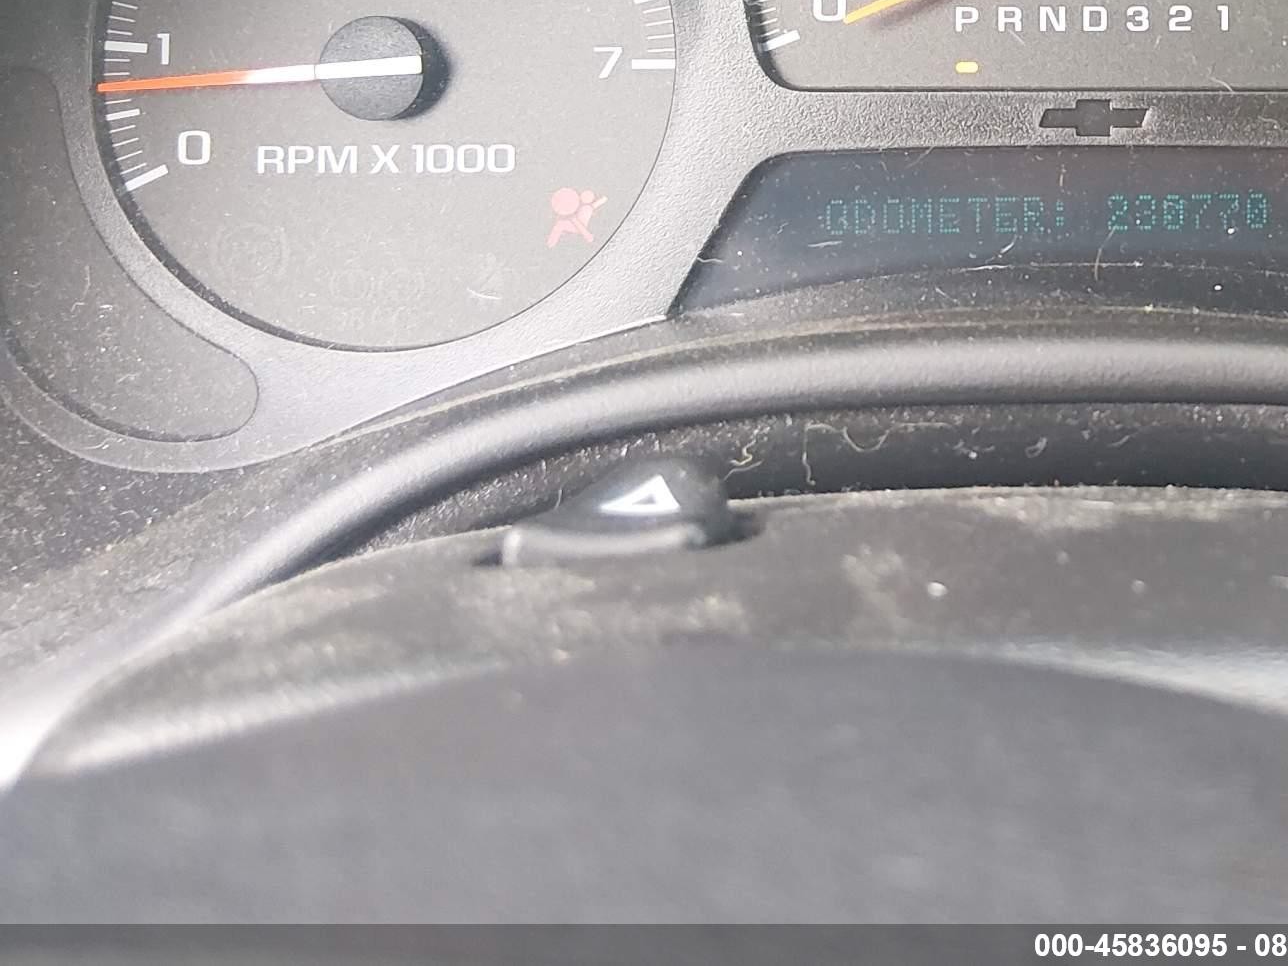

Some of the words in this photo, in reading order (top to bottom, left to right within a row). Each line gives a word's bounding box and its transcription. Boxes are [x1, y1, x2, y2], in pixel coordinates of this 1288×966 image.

[955, 6, 979, 32] P
[997, 6, 1022, 32] R
[1039, 6, 1066, 32] N
[1082, 5, 1108, 32] D
[1126, 5, 1150, 32] 3
[1168, 5, 1193, 31] 2
[1217, 5, 1229, 31] 1
[156, 33, 170, 65] 1
[593, 46, 623, 79] 7
[177, 130, 211, 165] 0
[257, 145, 358, 175] RPM
[369, 144, 401, 174] X
[411, 143, 516, 174] 1000
[827, 197, 1064, 234] ODOMETER:
